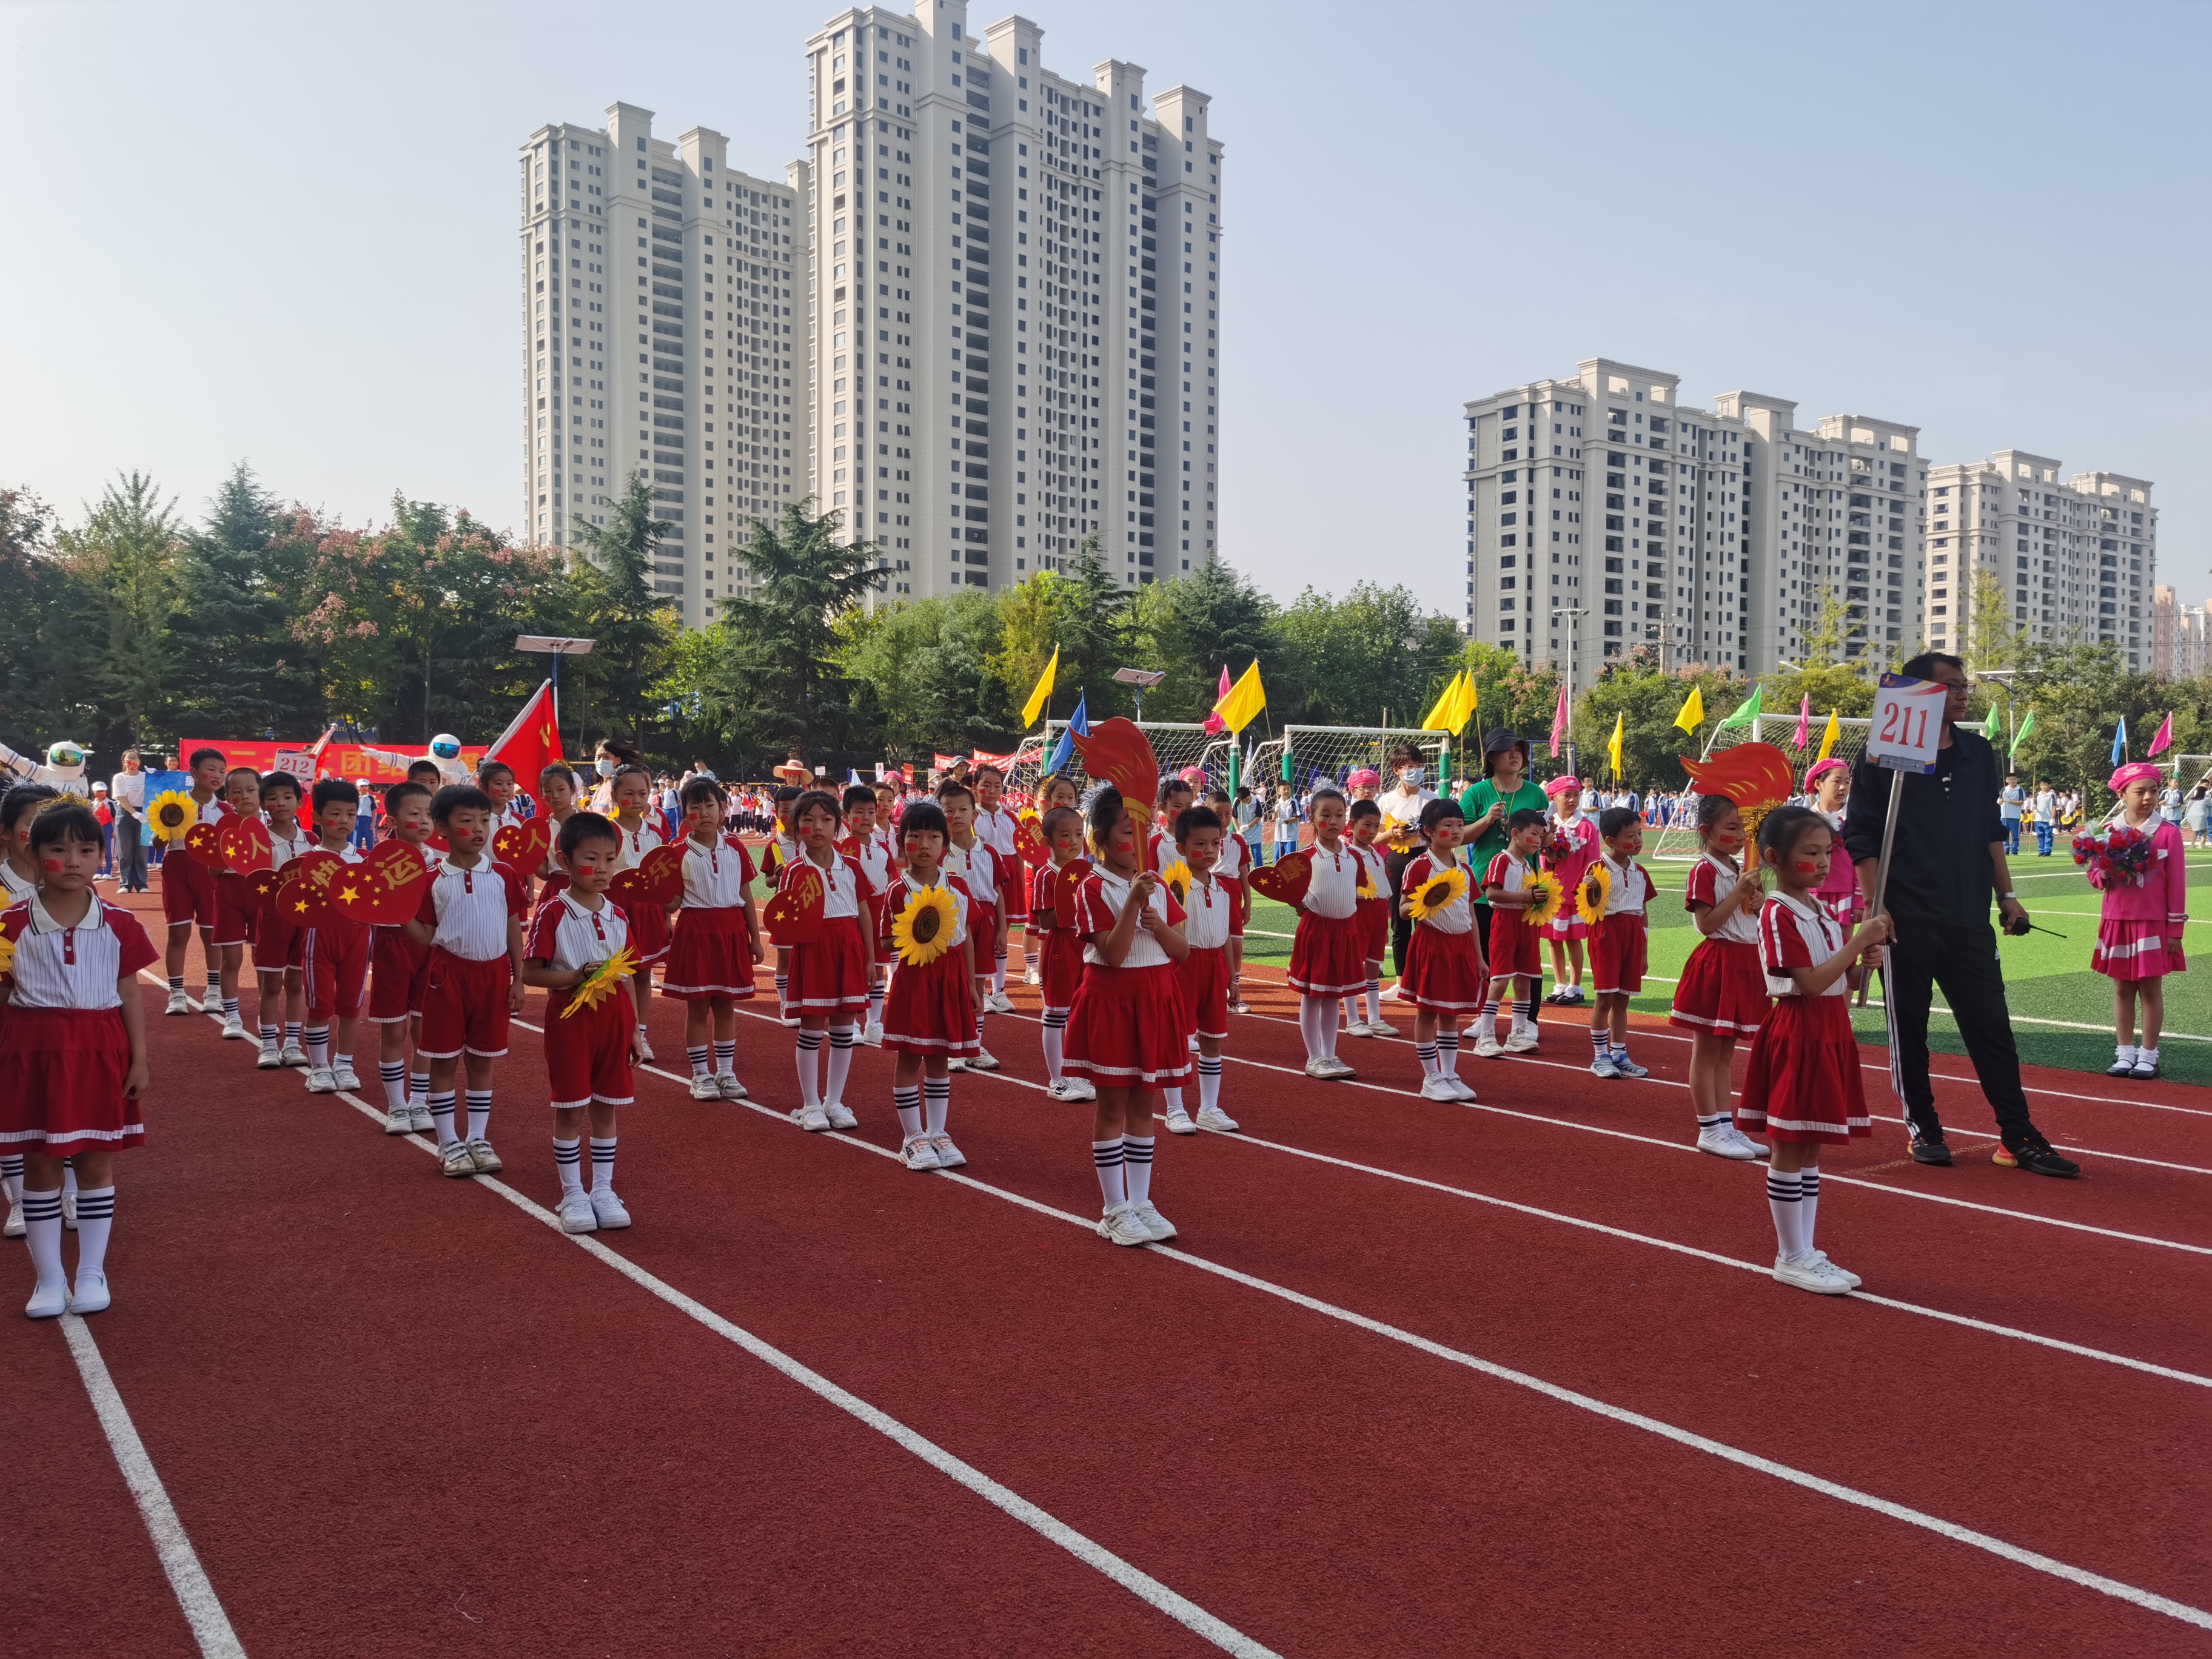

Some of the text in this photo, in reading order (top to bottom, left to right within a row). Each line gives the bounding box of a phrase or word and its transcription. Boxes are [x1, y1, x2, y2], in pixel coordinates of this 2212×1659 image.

[1880, 702, 1928, 748] 211
[280, 757, 309, 774] 212
[250, 832, 270, 860] 人
[526, 828, 548, 853] 人
[375, 848, 423, 891] 运
[648, 852, 679, 886] 乐
[1278, 856, 1307, 883] 康
[798, 873, 822, 910] 动
